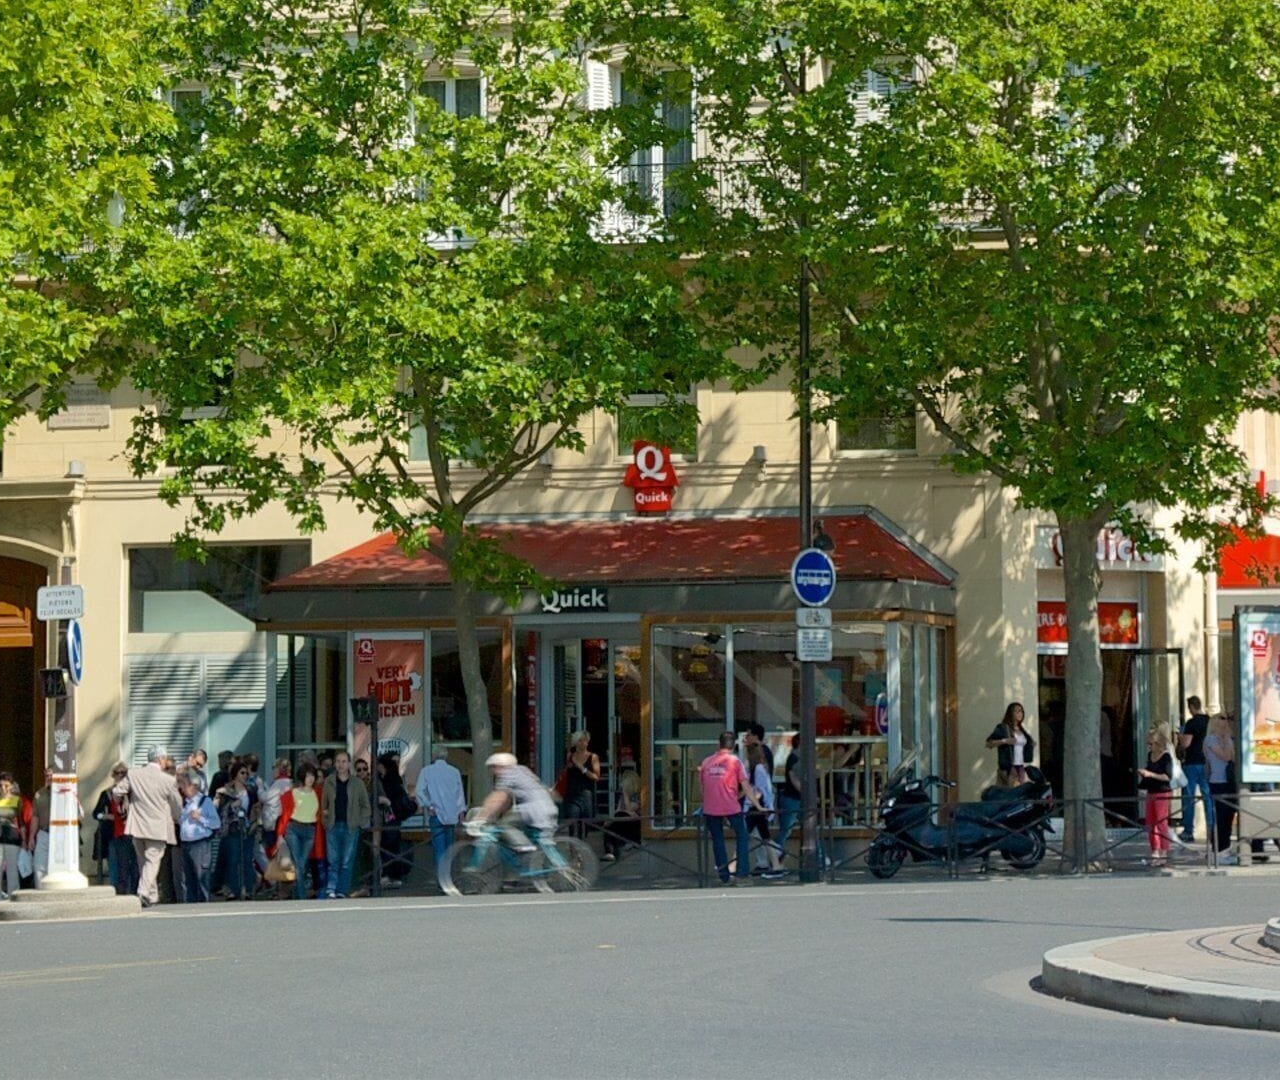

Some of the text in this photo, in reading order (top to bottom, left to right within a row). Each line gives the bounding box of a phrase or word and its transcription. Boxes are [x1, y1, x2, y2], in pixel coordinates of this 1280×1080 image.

[637, 445, 667, 481] Q
[635, 491, 668, 505] Quick
[540, 587, 606, 614] Quick
[377, 665, 407, 680] VERY
[367, 678, 413, 705] HOT
